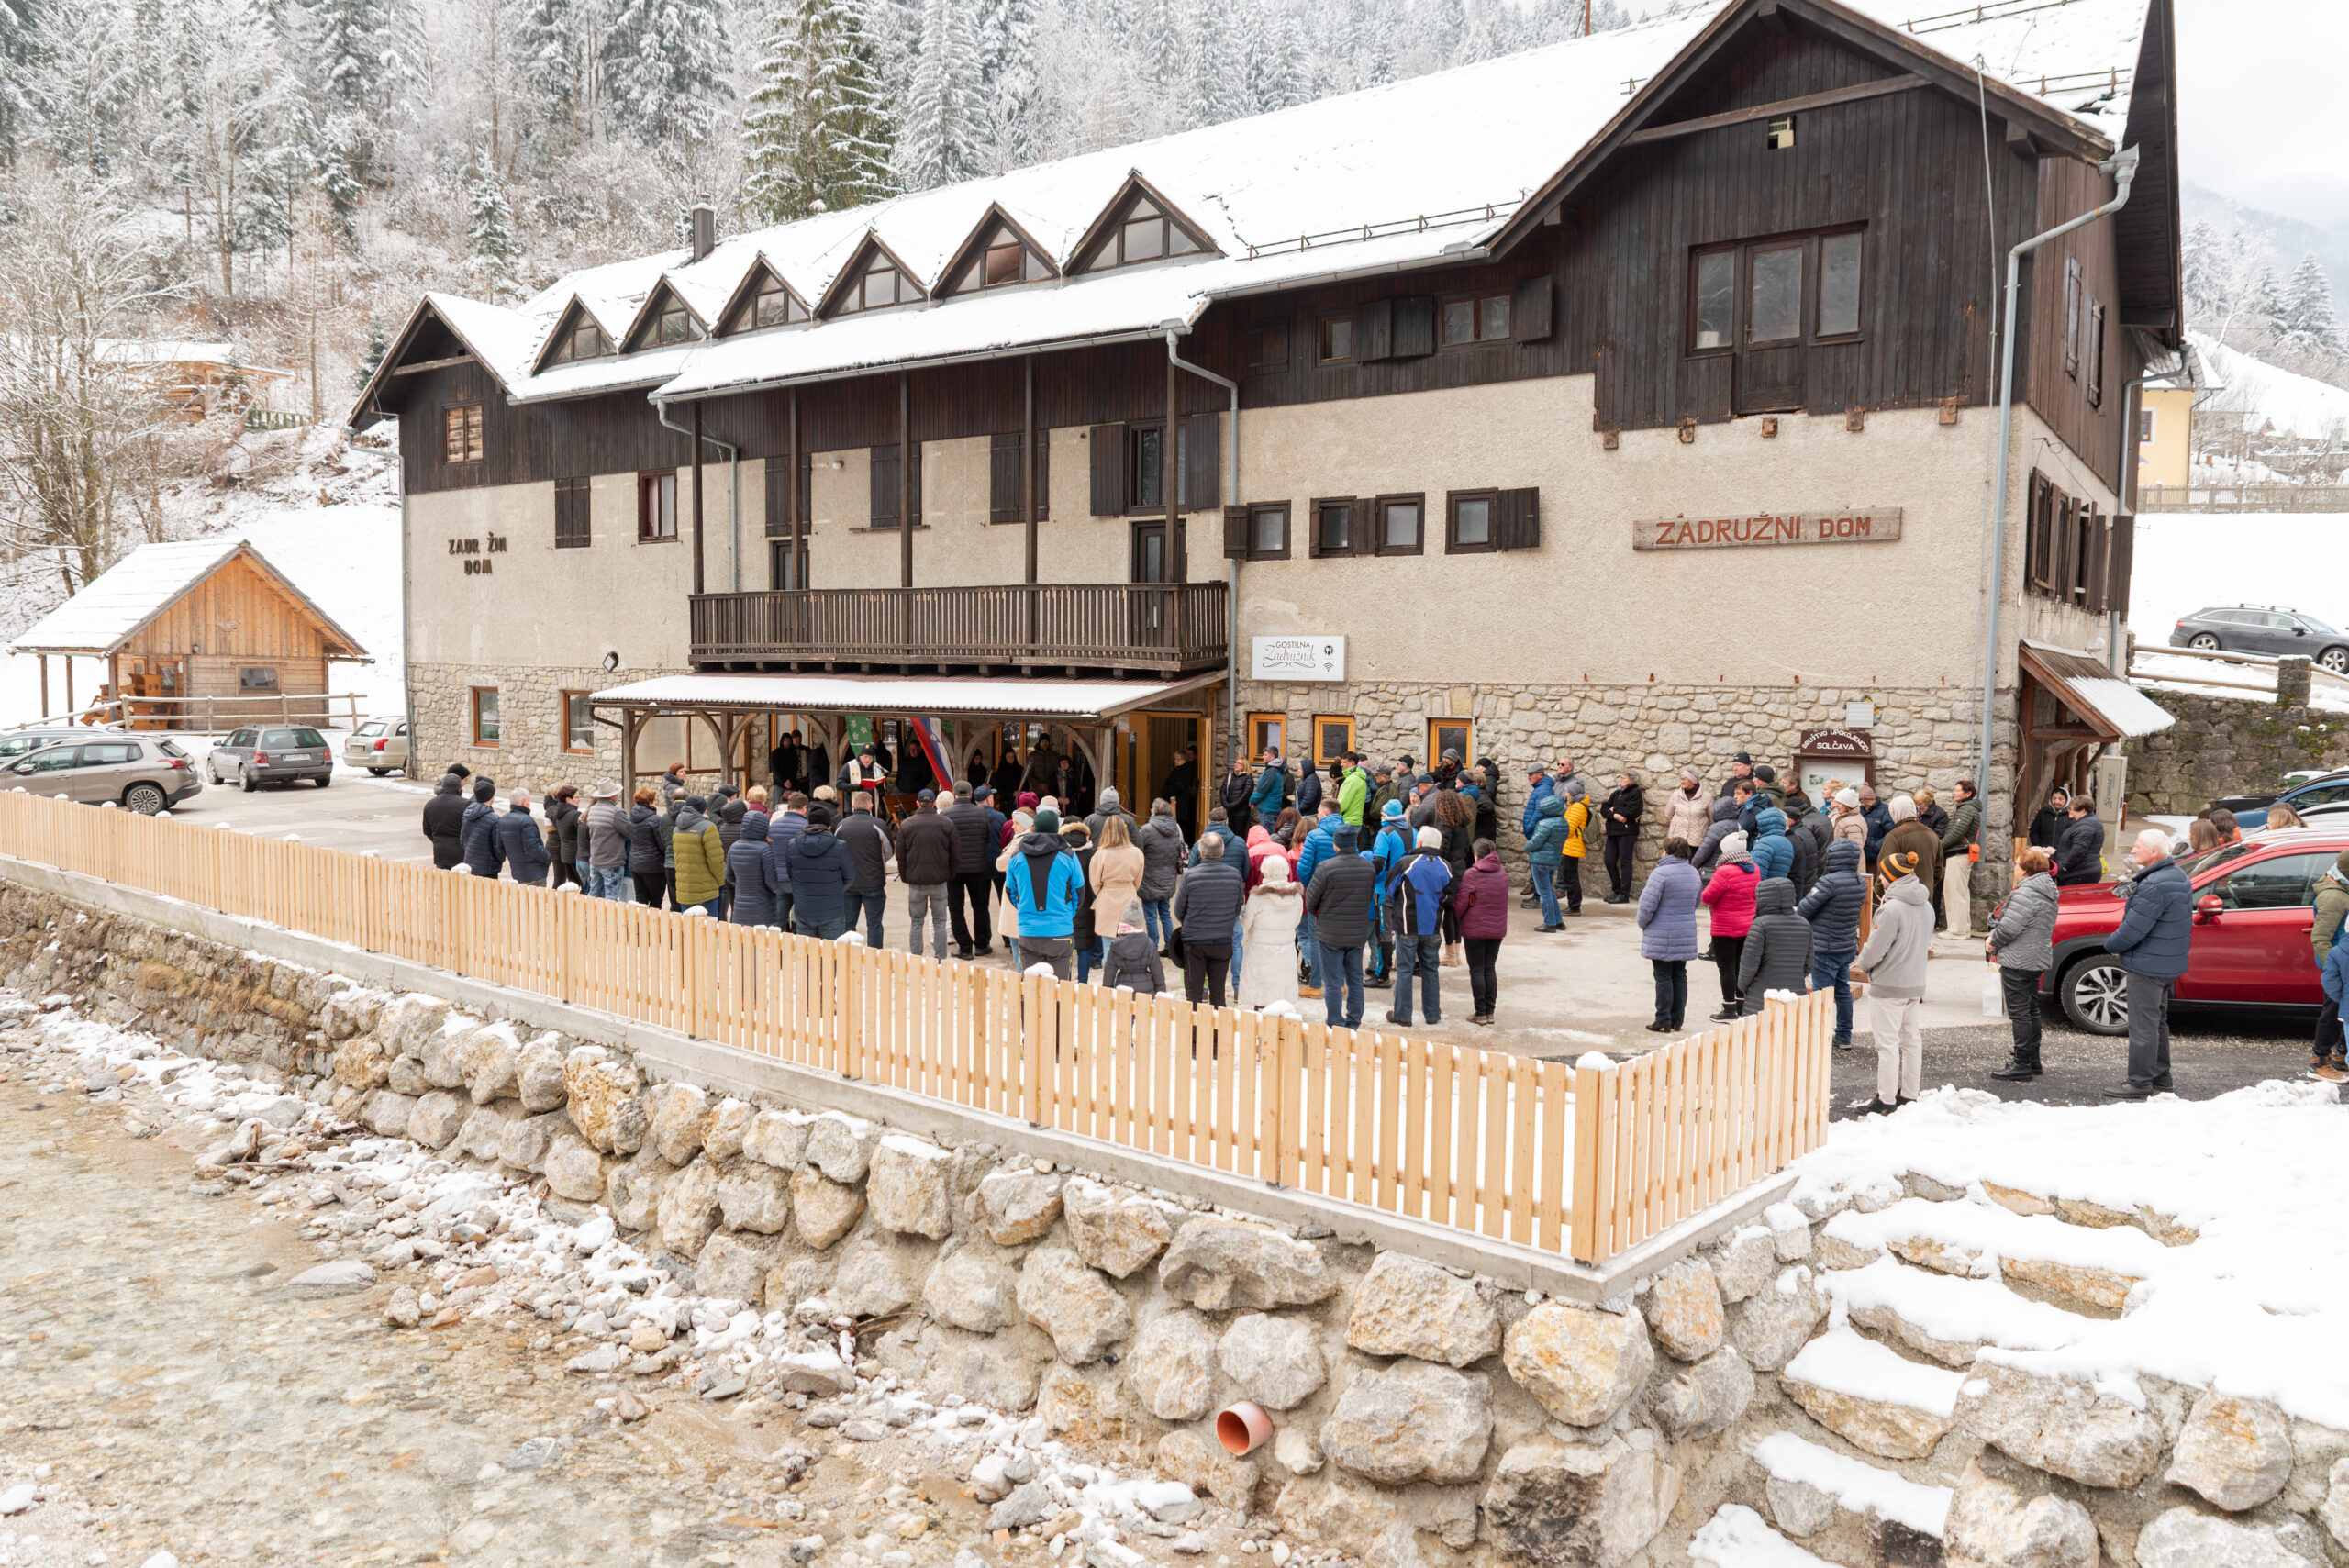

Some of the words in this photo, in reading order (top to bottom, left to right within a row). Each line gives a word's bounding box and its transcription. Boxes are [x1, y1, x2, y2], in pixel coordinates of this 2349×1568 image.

[1655, 513, 1801, 545] ZADRUŽNI
[1819, 517, 1871, 539] DOM
[464, 559, 493, 575] DOM
[1263, 644, 1316, 662] Zadružnik
[1801, 730, 1828, 749] DRUŠTVO
[1830, 729, 1871, 752] UPOKOJENCEV
[1816, 740, 1855, 751] SOLČAVA
